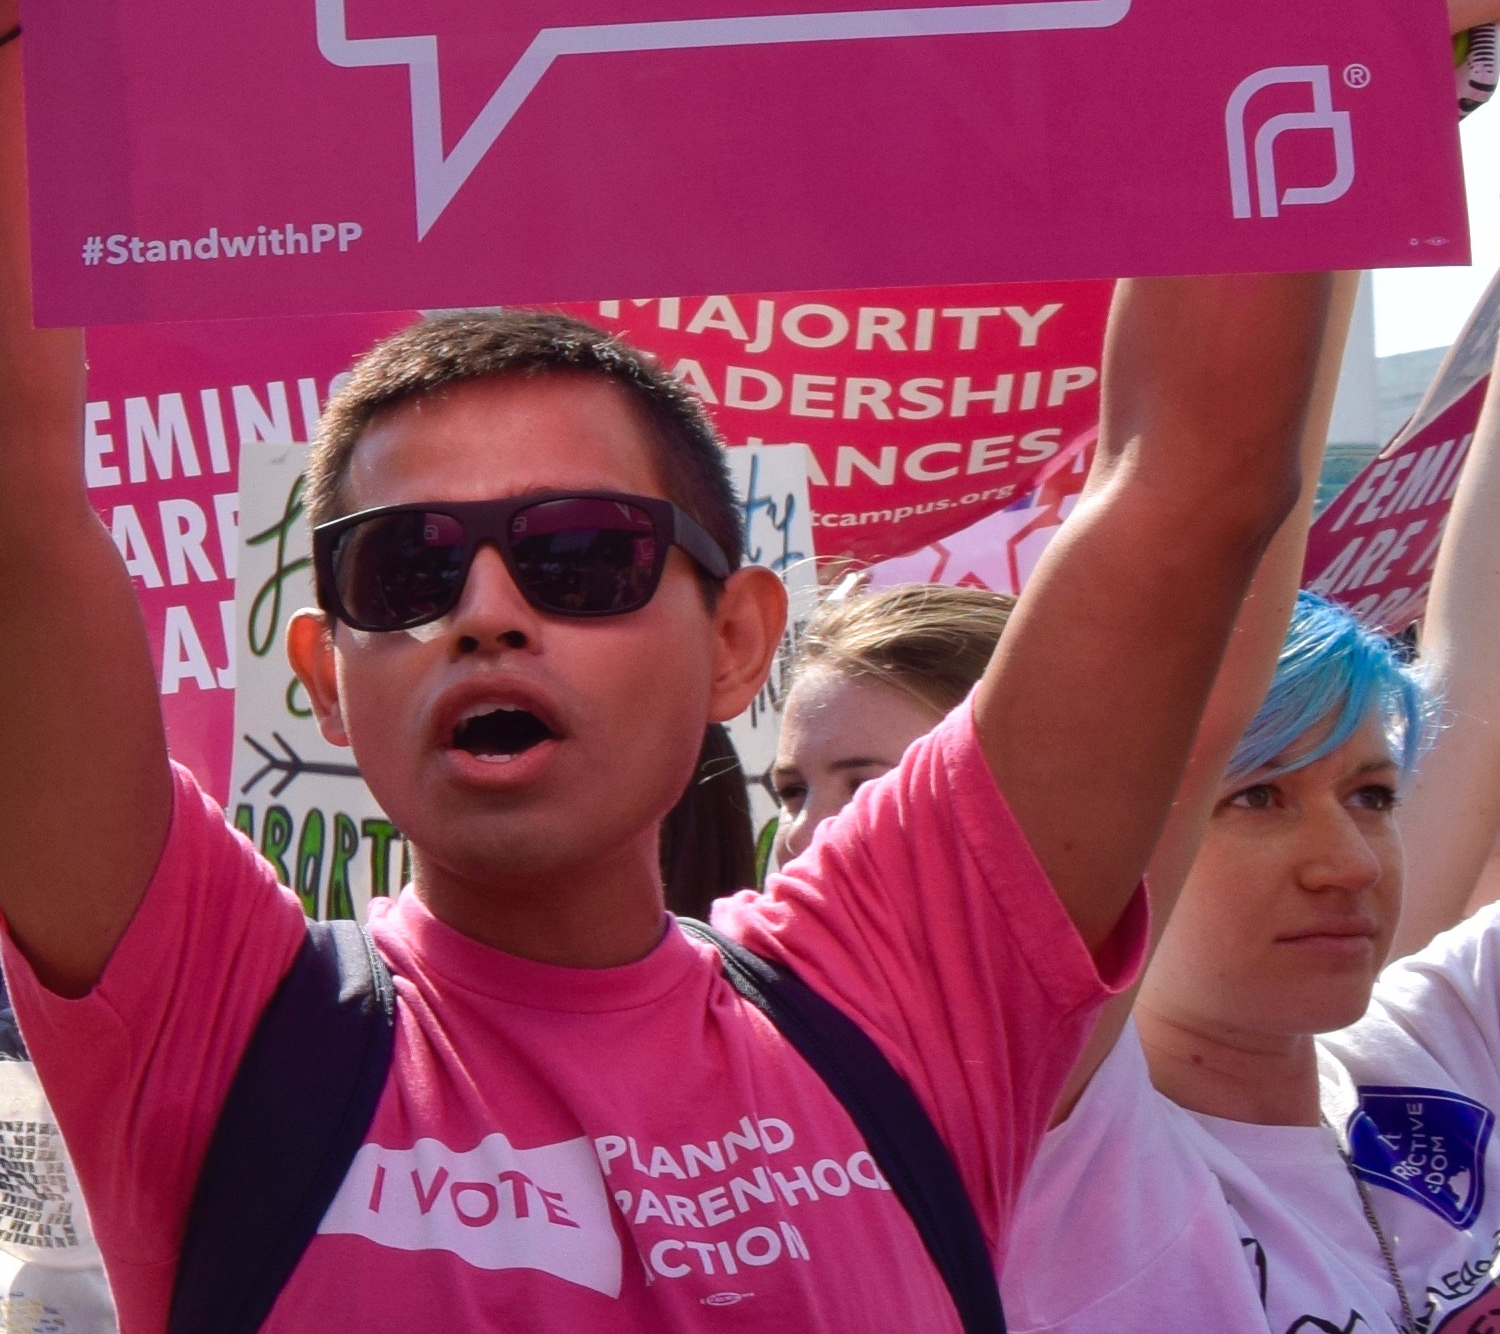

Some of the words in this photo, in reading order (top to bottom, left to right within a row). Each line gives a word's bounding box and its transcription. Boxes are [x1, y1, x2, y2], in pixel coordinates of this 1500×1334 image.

[80, 220, 364, 267] #StandwithPP
[368, 1163, 387, 1215] I
[409, 1165, 582, 1230] VOTE
